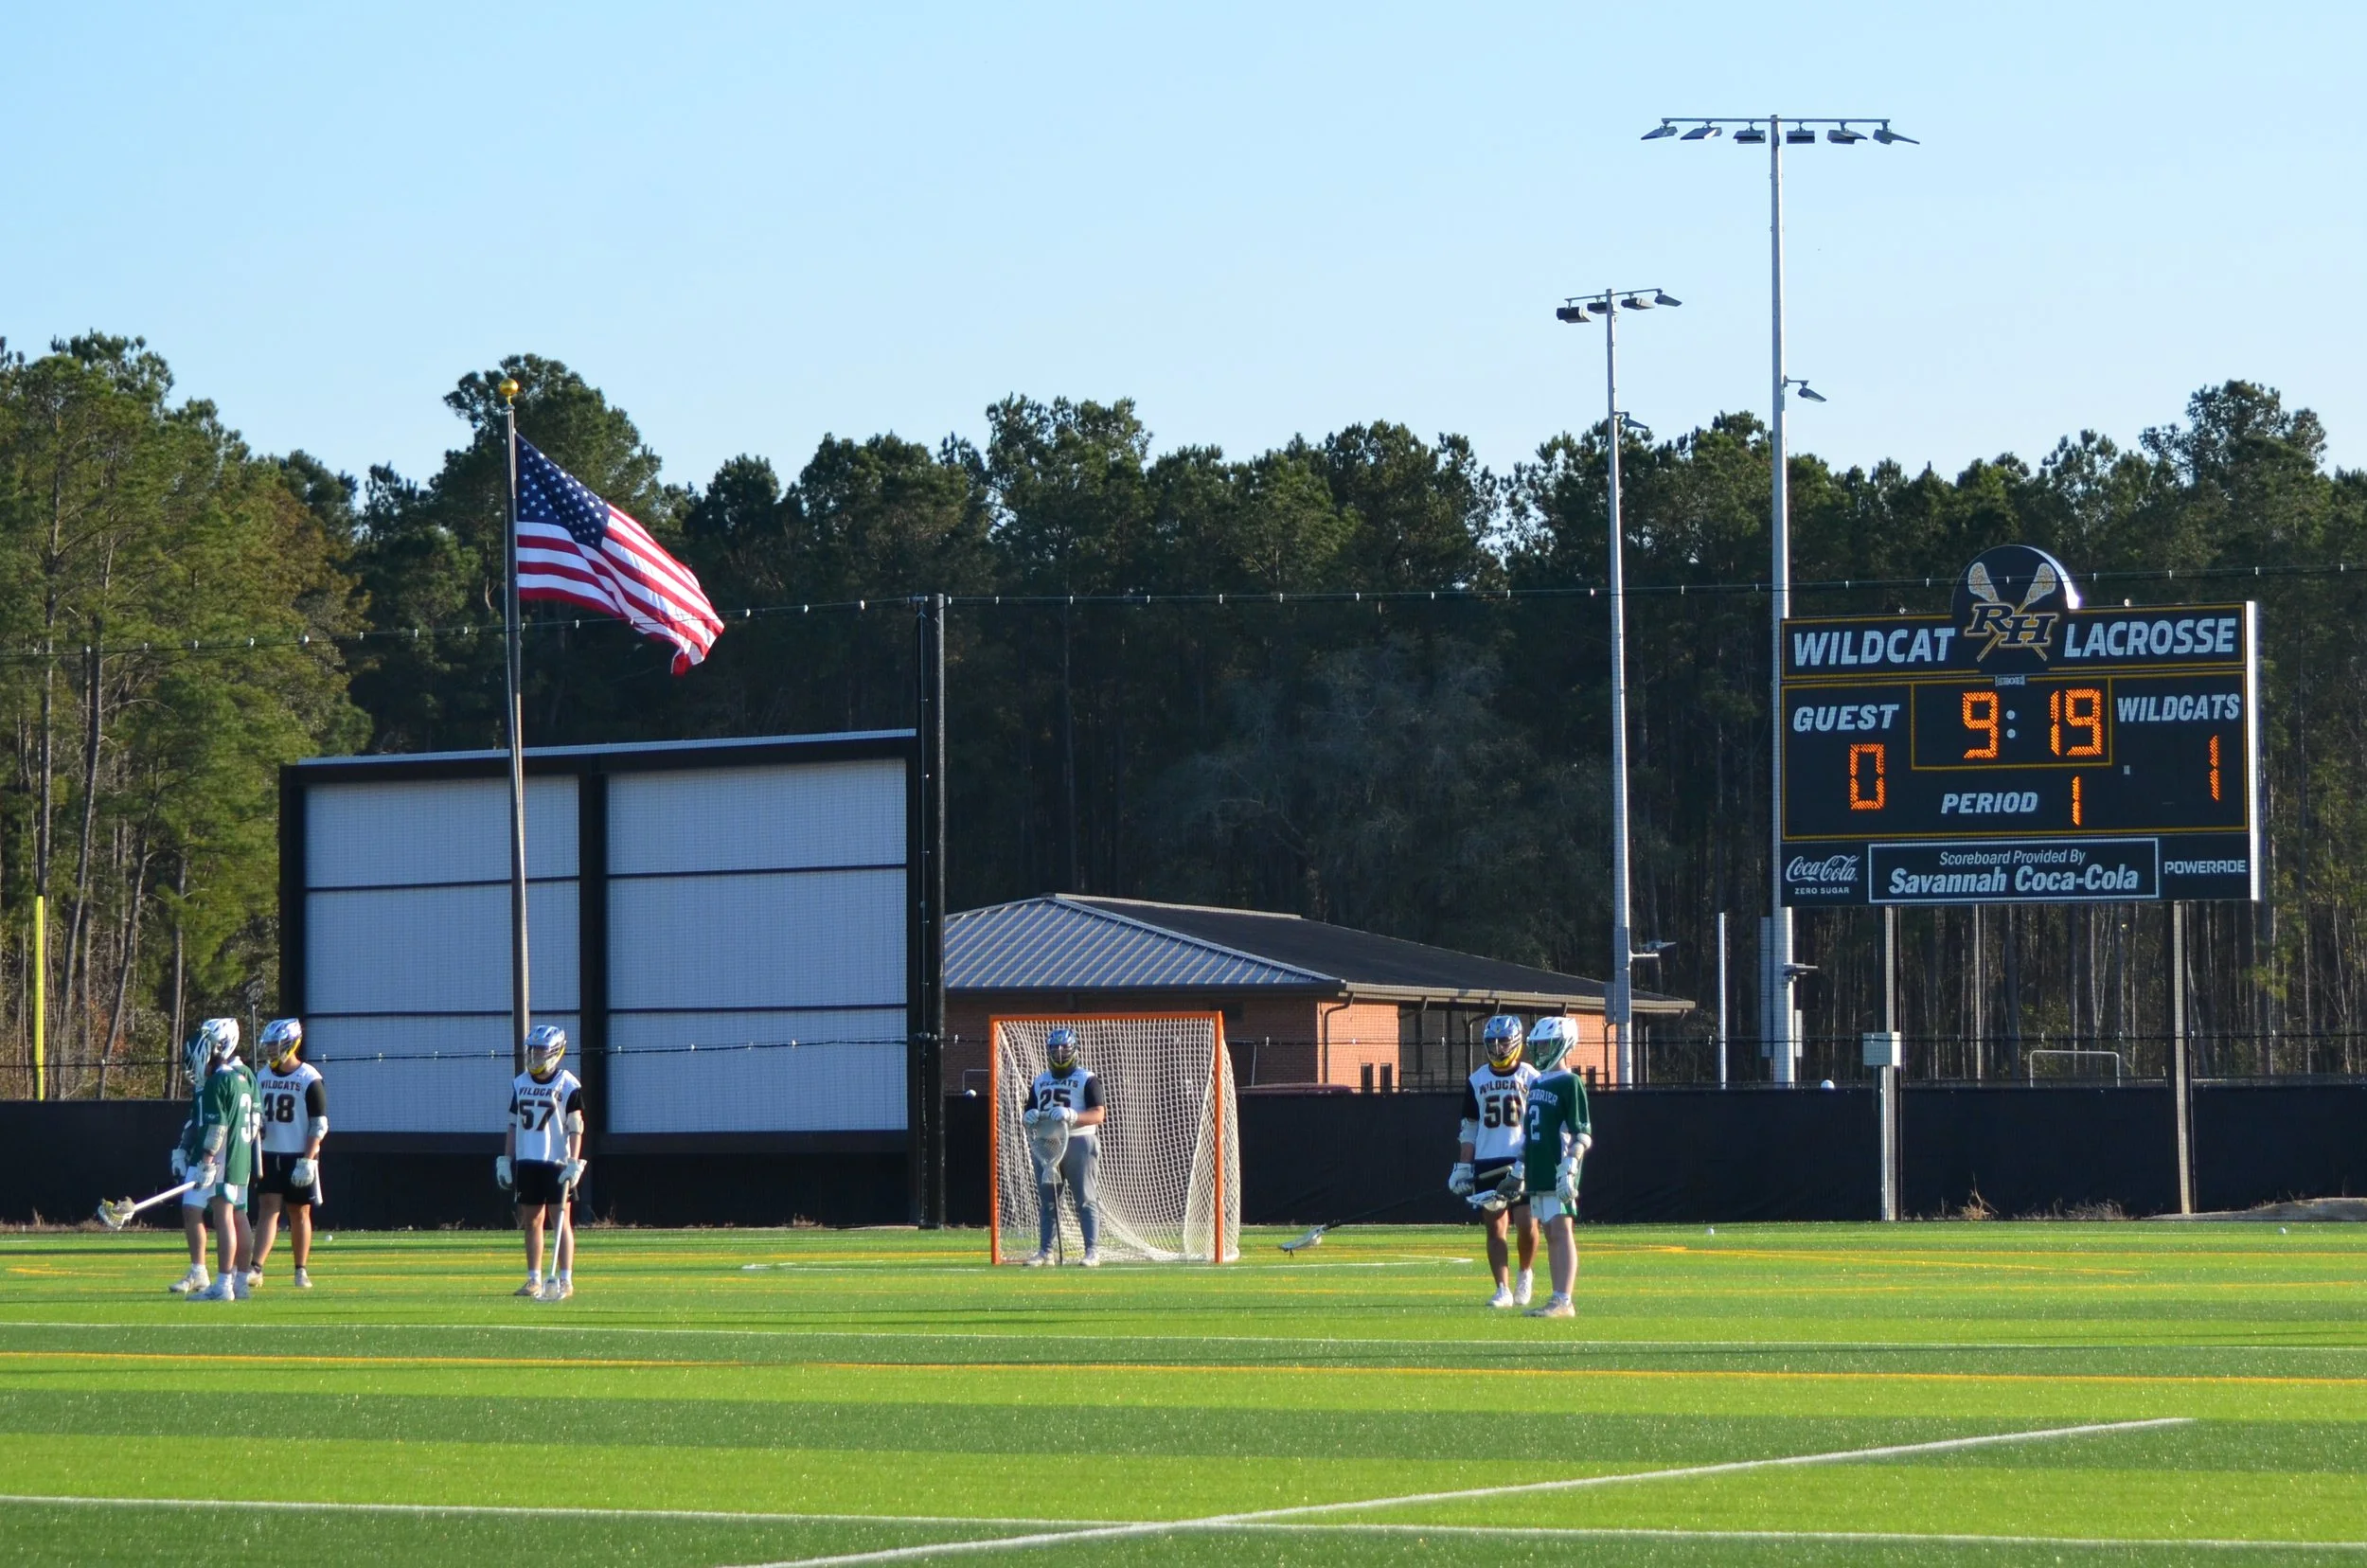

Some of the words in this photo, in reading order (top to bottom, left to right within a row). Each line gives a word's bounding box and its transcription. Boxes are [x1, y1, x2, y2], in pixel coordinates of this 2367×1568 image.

[1964, 602, 2060, 648] RH
[2063, 617, 2237, 658] LACROSSE
[1793, 627, 1956, 667] WILDCAT
[1792, 704, 1900, 732] GUEST
[2117, 693, 2241, 722] WILDCATS
[1849, 743, 1885, 810] 0
[2209, 735, 2220, 801] 1
[1941, 792, 2038, 814] PERIOD
[2071, 775, 2081, 826] 1
[1786, 855, 1860, 882] Coca-Cola
[1939, 850, 2011, 865] Scoreboard
[2013, 849, 2067, 864] Provided
[2069, 848, 2086, 866] By
[2164, 860, 2248, 875] POWERADE
[1820, 886, 1850, 895] SUGAR
[1888, 865, 2007, 895] Savannah
[2015, 864, 2140, 892] Coca-Cola
[260, 1080, 301, 1092] WILDCATS
[1040, 1088, 1071, 1112] 25
[263, 1092, 296, 1124] 48
[519, 1098, 557, 1131] 57
[1483, 1094, 1522, 1129] 56
[1528, 1104, 1540, 1141] 2
